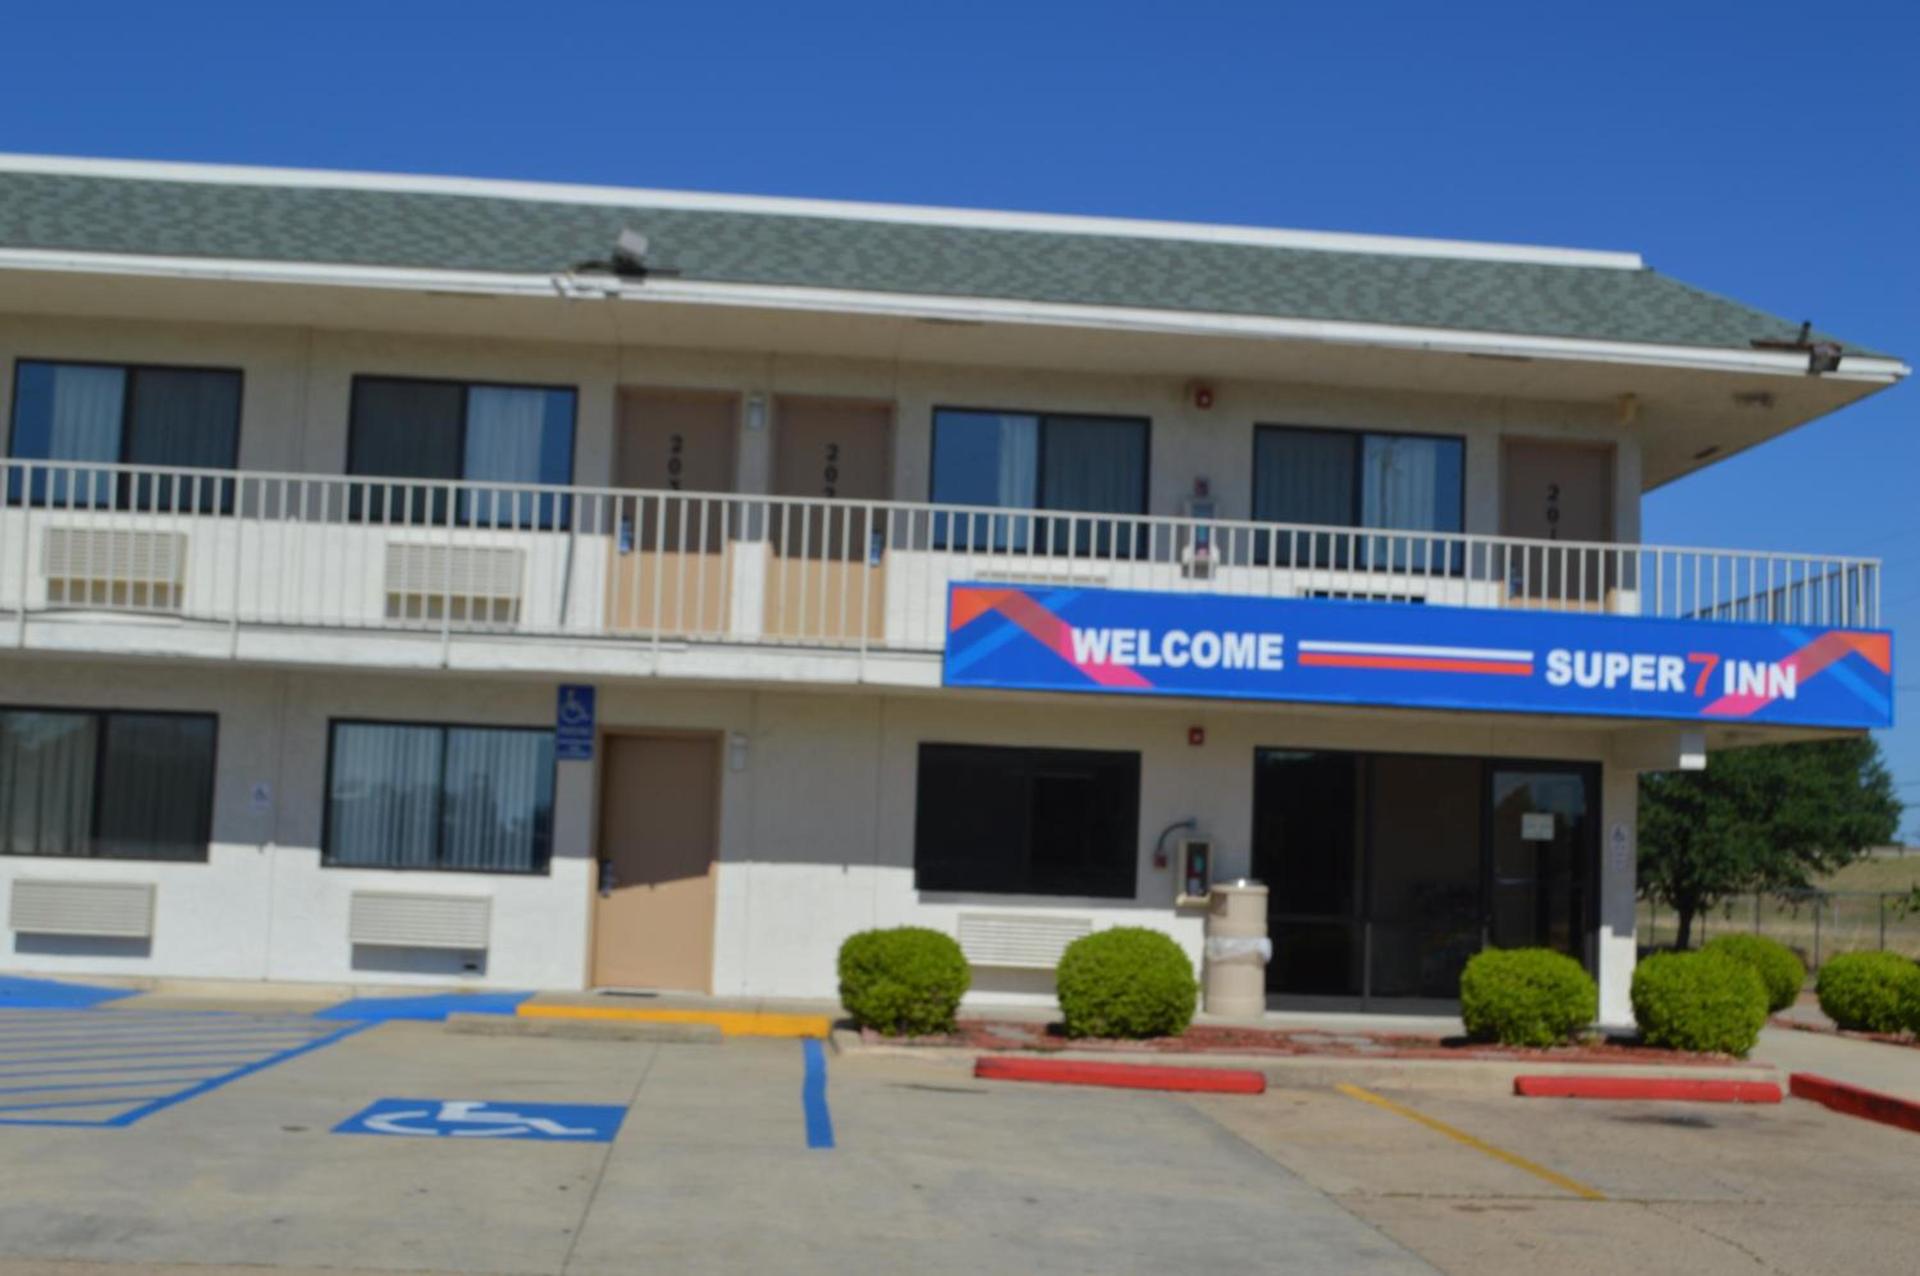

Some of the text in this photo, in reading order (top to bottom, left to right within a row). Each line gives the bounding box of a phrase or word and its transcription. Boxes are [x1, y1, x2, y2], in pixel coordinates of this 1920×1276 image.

[1071, 627, 1284, 671] WELCOME
[1546, 649, 1796, 699] SUPER 7 INN
